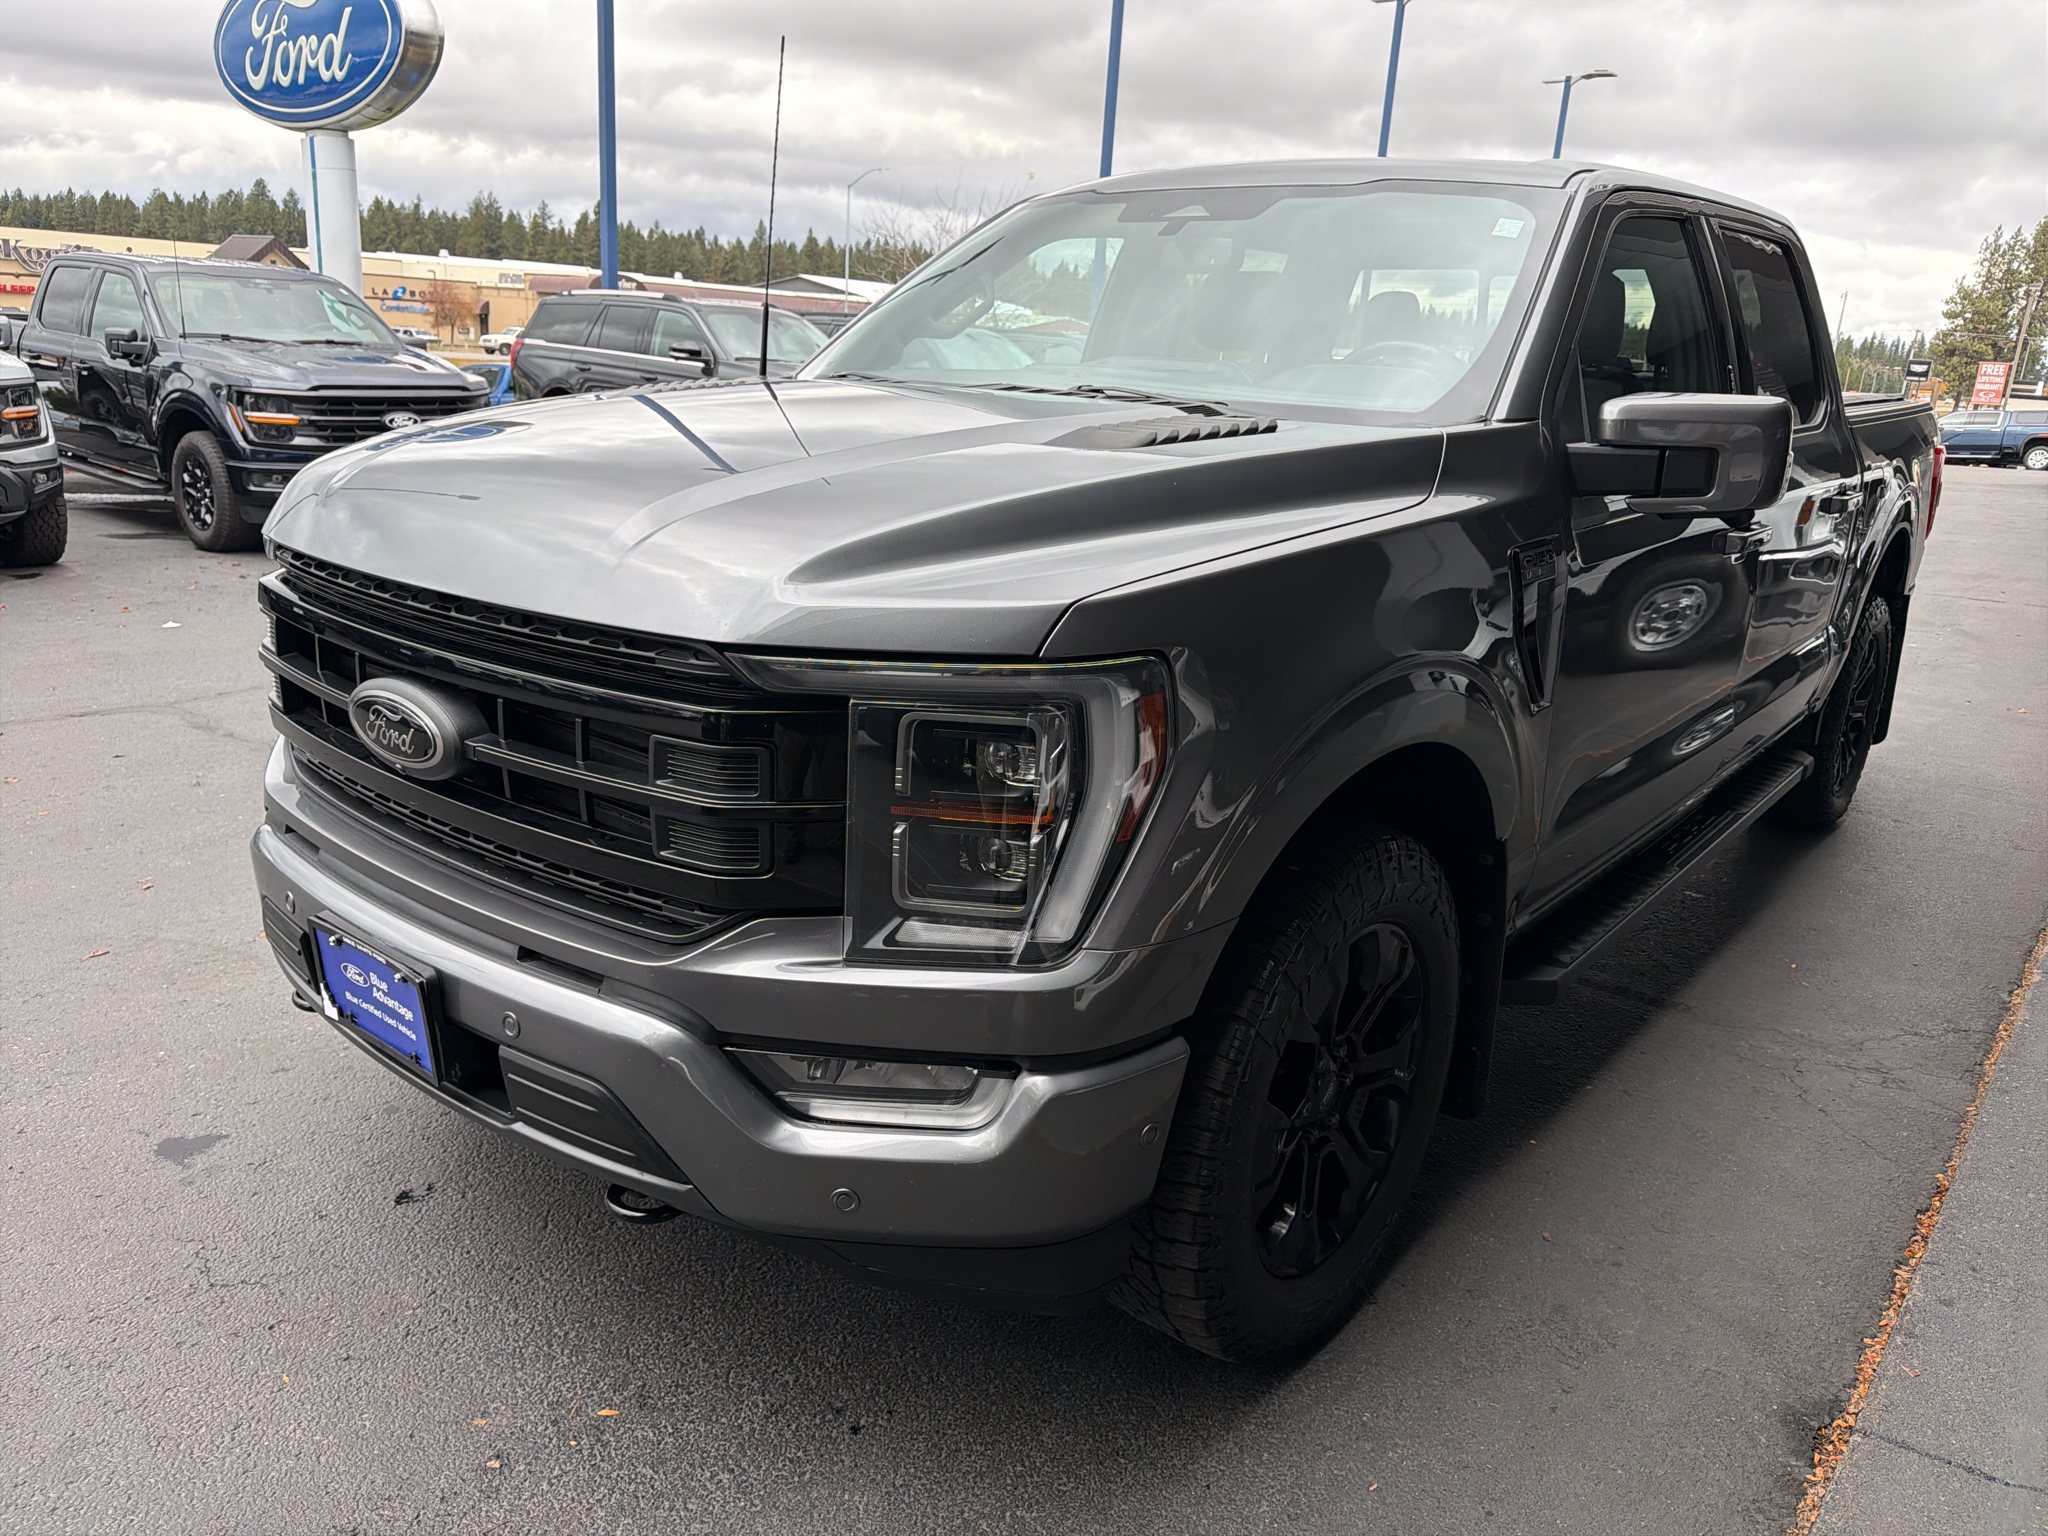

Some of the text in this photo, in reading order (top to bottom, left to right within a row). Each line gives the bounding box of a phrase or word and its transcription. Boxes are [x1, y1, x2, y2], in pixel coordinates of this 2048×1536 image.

[245, 0, 352, 91] Ford
[1977, 375, 2005, 384] LIFETIME
[1981, 363, 2005, 376] FREE
[365, 704, 415, 754] Ford
[346, 965, 365, 985] Ford
[369, 971, 389, 993] Blue
[345, 991, 417, 1042] Blue Certified Used Vehicle
[372, 986, 414, 1022] Advantage
